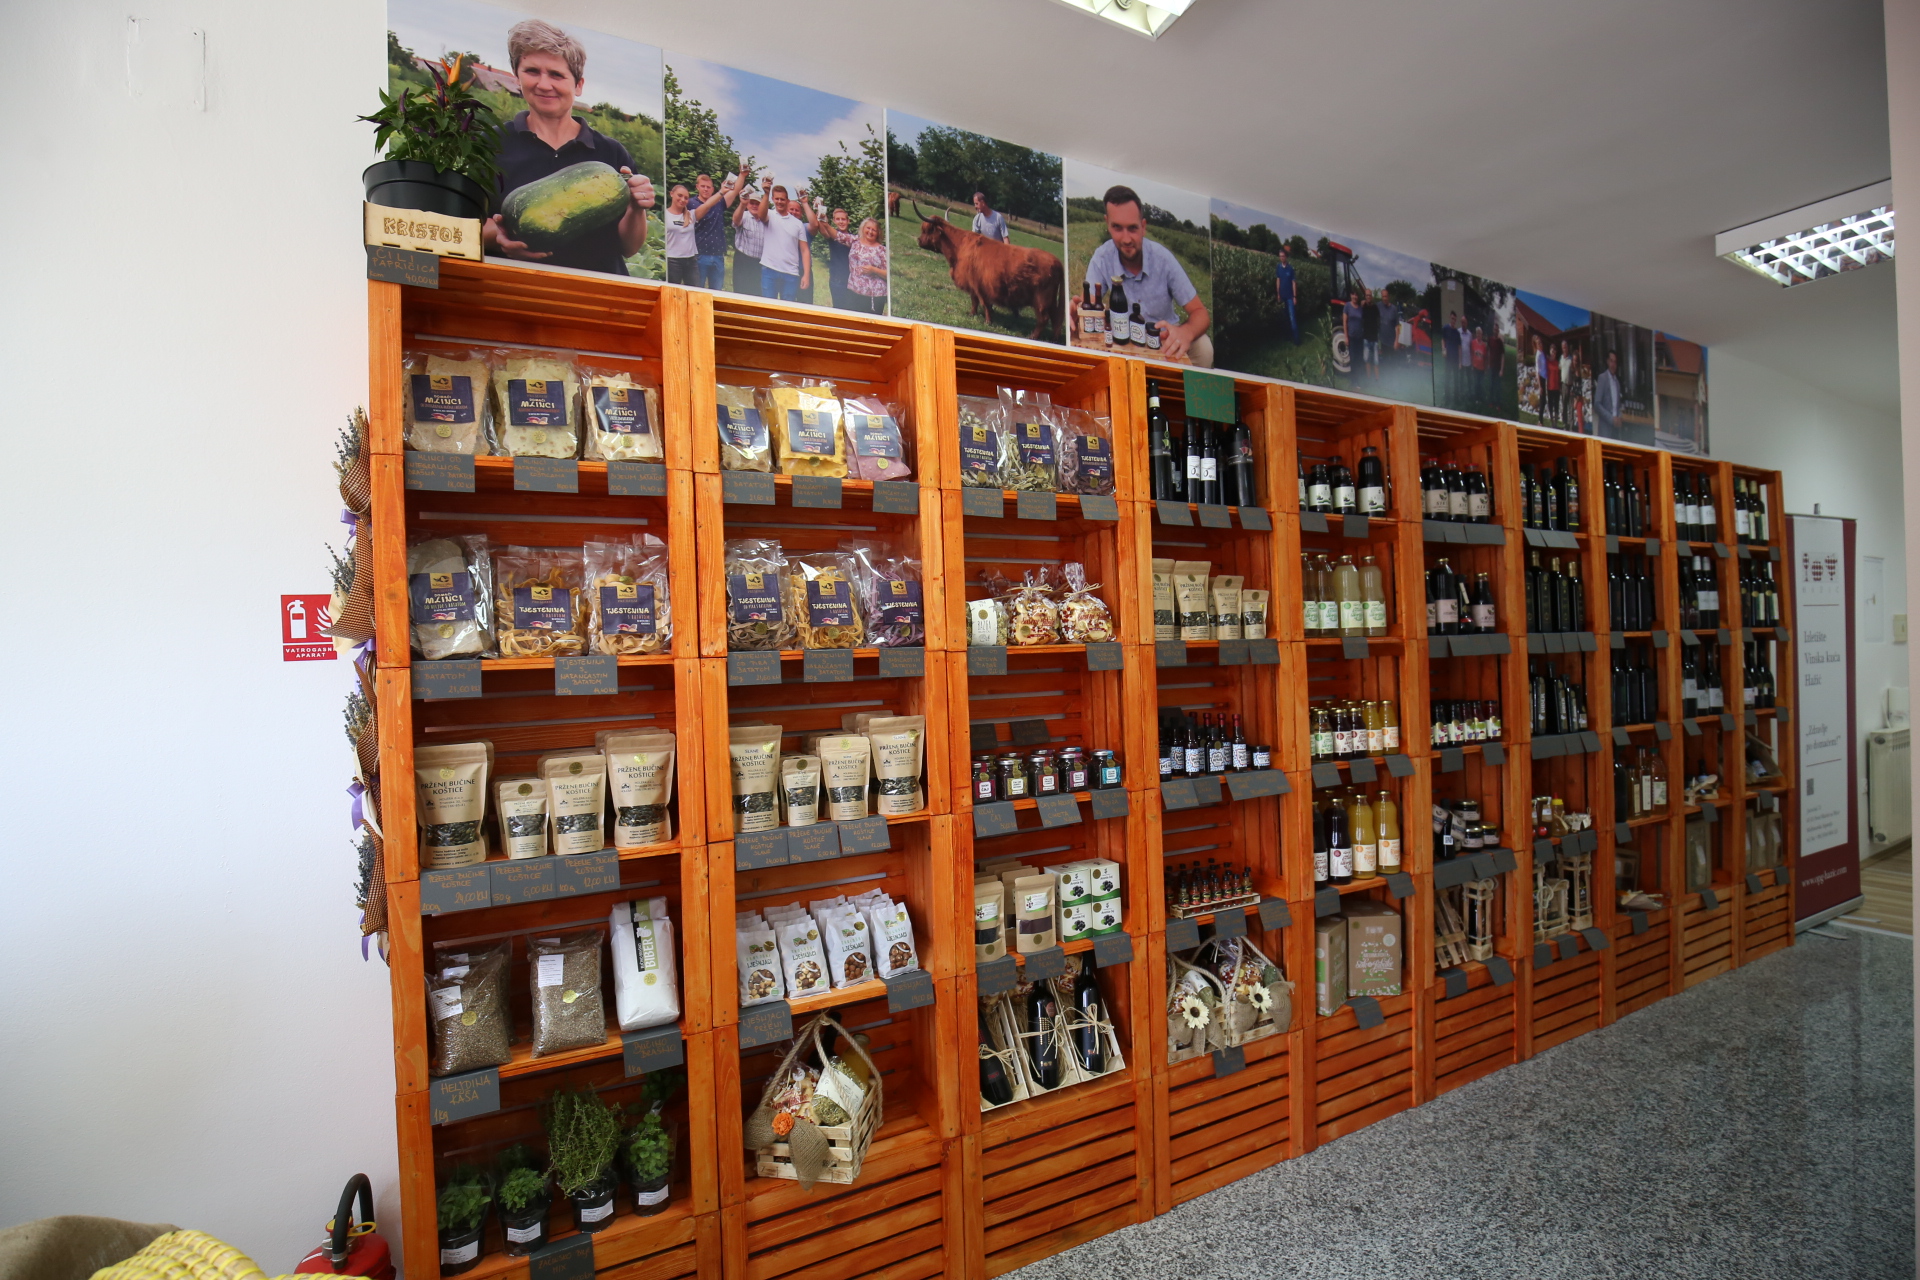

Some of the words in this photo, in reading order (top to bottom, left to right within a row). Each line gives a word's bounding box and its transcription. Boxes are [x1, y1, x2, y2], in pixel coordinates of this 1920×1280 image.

[383, 217, 463, 244] KRISTOŠ
[376, 248, 414, 262] ČILI
[372, 257, 436, 272] PAPRIČICA
[1803, 630, 1827, 643] Izletište
[1804, 652, 1825, 664] Vinska
[1826, 651, 1841, 663] kuća
[558, 658, 606, 669] TJESTENINA
[424, 672, 466, 680] BATATOM
[560, 671, 608, 680] NARANČASTIM
[879, 743, 898, 751] PRŽENE
[642, 763, 665, 772] BUČINE
[741, 760, 766, 768] KOŠTICE
[628, 771, 655, 779] KOŠTICE
[420, 779, 447, 790] PRŽENE
[448, 778, 475, 786] BUČINE
[432, 786, 464, 795] KOŠTICE
[842, 822, 862, 830] PRŽENE
[762, 833, 784, 841] BUČINE
[788, 830, 811, 838] PRŽENE
[803, 836, 825, 844] KOŠTICE
[564, 858, 592, 868] PRŽENE
[592, 854, 619, 864] BUČINE
[495, 866, 522, 876] PRŽENE
[523, 862, 553, 872] BUČINE
[574, 865, 605, 875] KOŠTICE
[427, 874, 454, 883] PRŽENE
[456, 870, 486, 880] BUČINE
[507, 871, 542, 882] KOŠTICE
[441, 880, 472, 889] KOŠTICE
[583, 876, 601, 889] 12,00
[523, 885, 540, 898] 6,00
[642, 937, 656, 968] BIBER
[747, 959, 773, 968] LJEŠNJACI
[742, 1011, 786, 1028] LJEŠNJACI
[633, 1037, 668, 1054] BUČINO
[627, 1064, 642, 1074] 1kg
[441, 1074, 491, 1095] HELJDINA
[449, 1089, 479, 1105] KAŠA
[433, 1108, 449, 1123] 1kg
